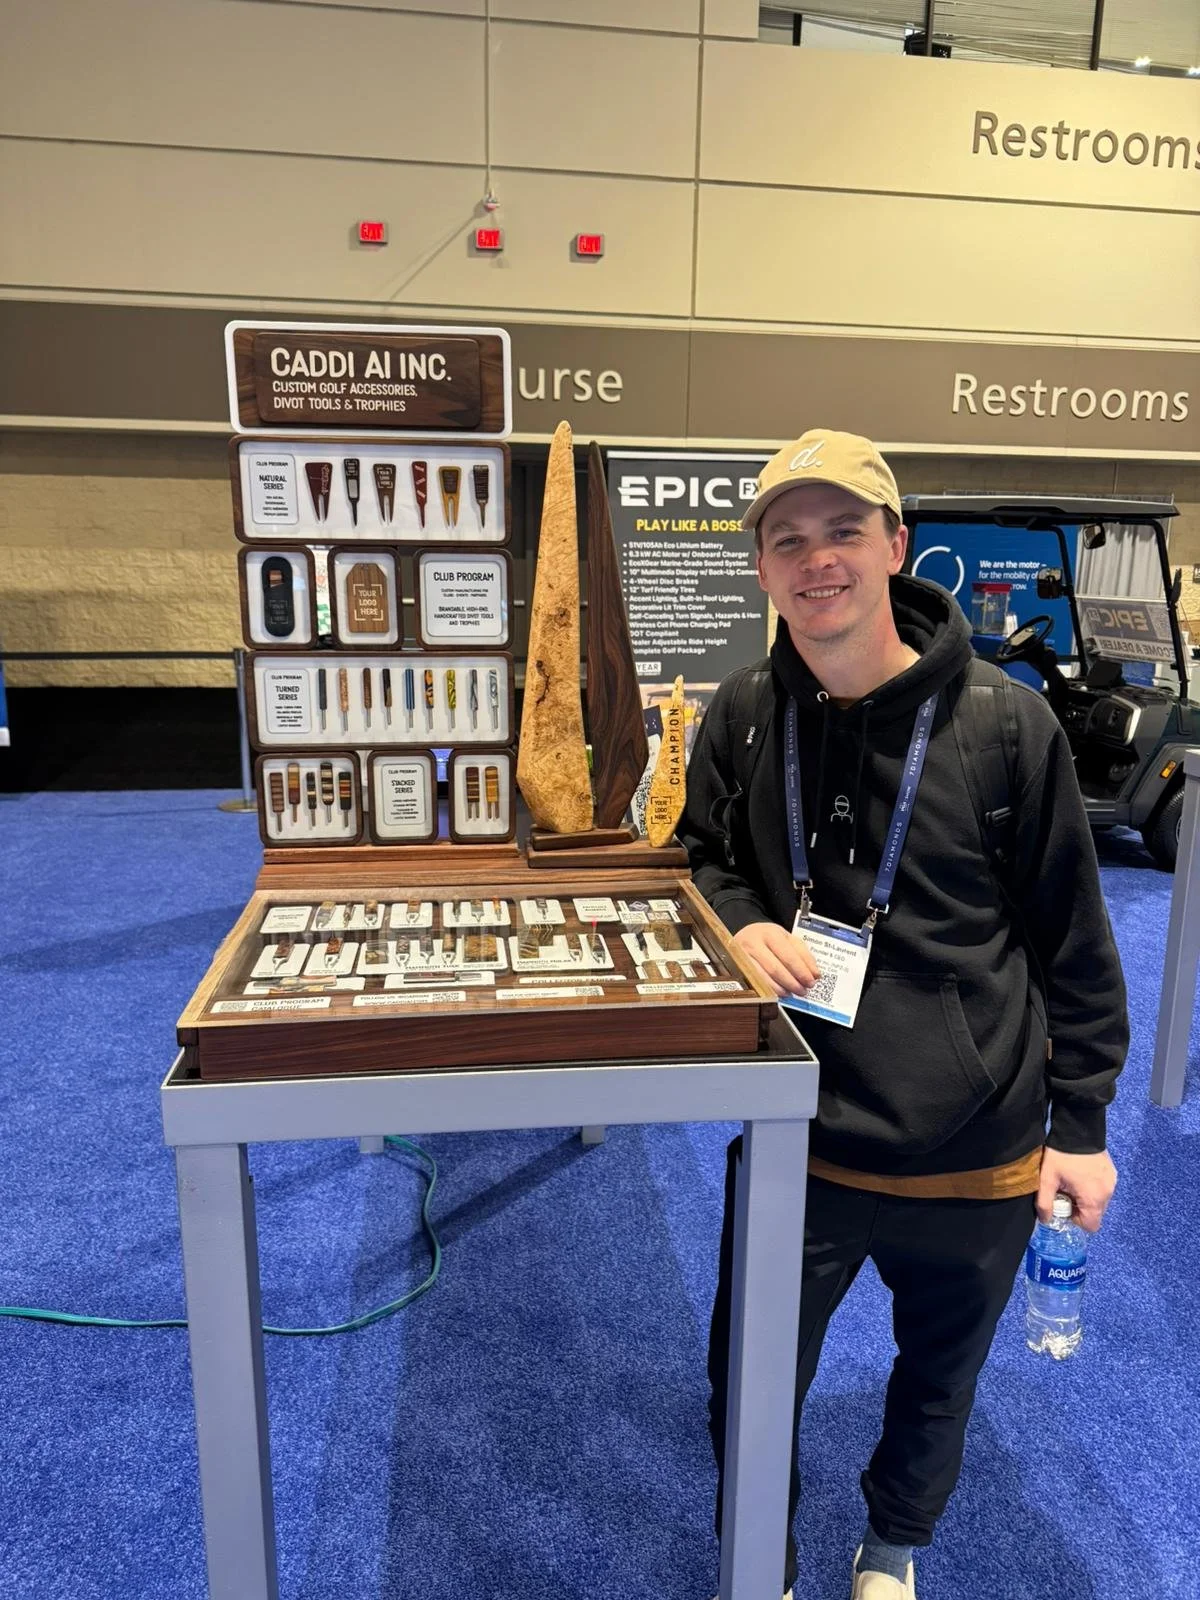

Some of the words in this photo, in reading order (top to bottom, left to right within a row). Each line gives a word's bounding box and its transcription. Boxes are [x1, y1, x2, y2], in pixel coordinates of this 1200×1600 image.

[271, 347, 354, 378] CADDI
[364, 351, 390, 379] AI
[400, 353, 452, 381] INC.
[273, 381, 317, 393] CUSTOM
[320, 382, 347, 394] GOLF
[350, 383, 418, 397] ACCESSORIES,
[518, 367, 623, 403] urse
[952, 373, 1189, 422] Restrooms
[274, 397, 304, 409] DIVOT
[309, 398, 341, 410] TOOLS
[344, 401, 353, 410] &
[353, 399, 406, 412] TROPHIES
[617, 476, 733, 507] EPIC
[636, 519, 669, 531] PLAY
[672, 519, 697, 531] LIKE
[699, 520, 709, 531] A
[700, 542, 723, 550] Battery
[722, 551, 749, 559] Charger
[725, 560, 748, 568] System
[980, 560, 992, 568] We
[1006, 560, 1017, 568] the
[433, 572, 455, 581] CLUB
[457, 572, 494, 581] PROGRAM
[676, 569, 699, 577] Display
[978, 571, 989, 579] for
[991, 571, 1002, 579] the
[1003, 571, 1030, 581] mobility
[359, 589, 376, 597] YOUR
[655, 587, 679, 595] Friendly
[359, 599, 377, 607] LOGO
[361, 608, 378, 616] HERE
[690, 621, 718, 629] Charging
[652, 639, 687, 647] Adjustable
[704, 639, 727, 647] Height
[275, 685, 300, 693] TURNED
[278, 693, 298, 701] SERIES
[669, 708, 681, 786] CHAMPION
[909, 726, 925, 776] 7DIAMONDS
[885, 821, 903, 872] 7DIAMONDS
